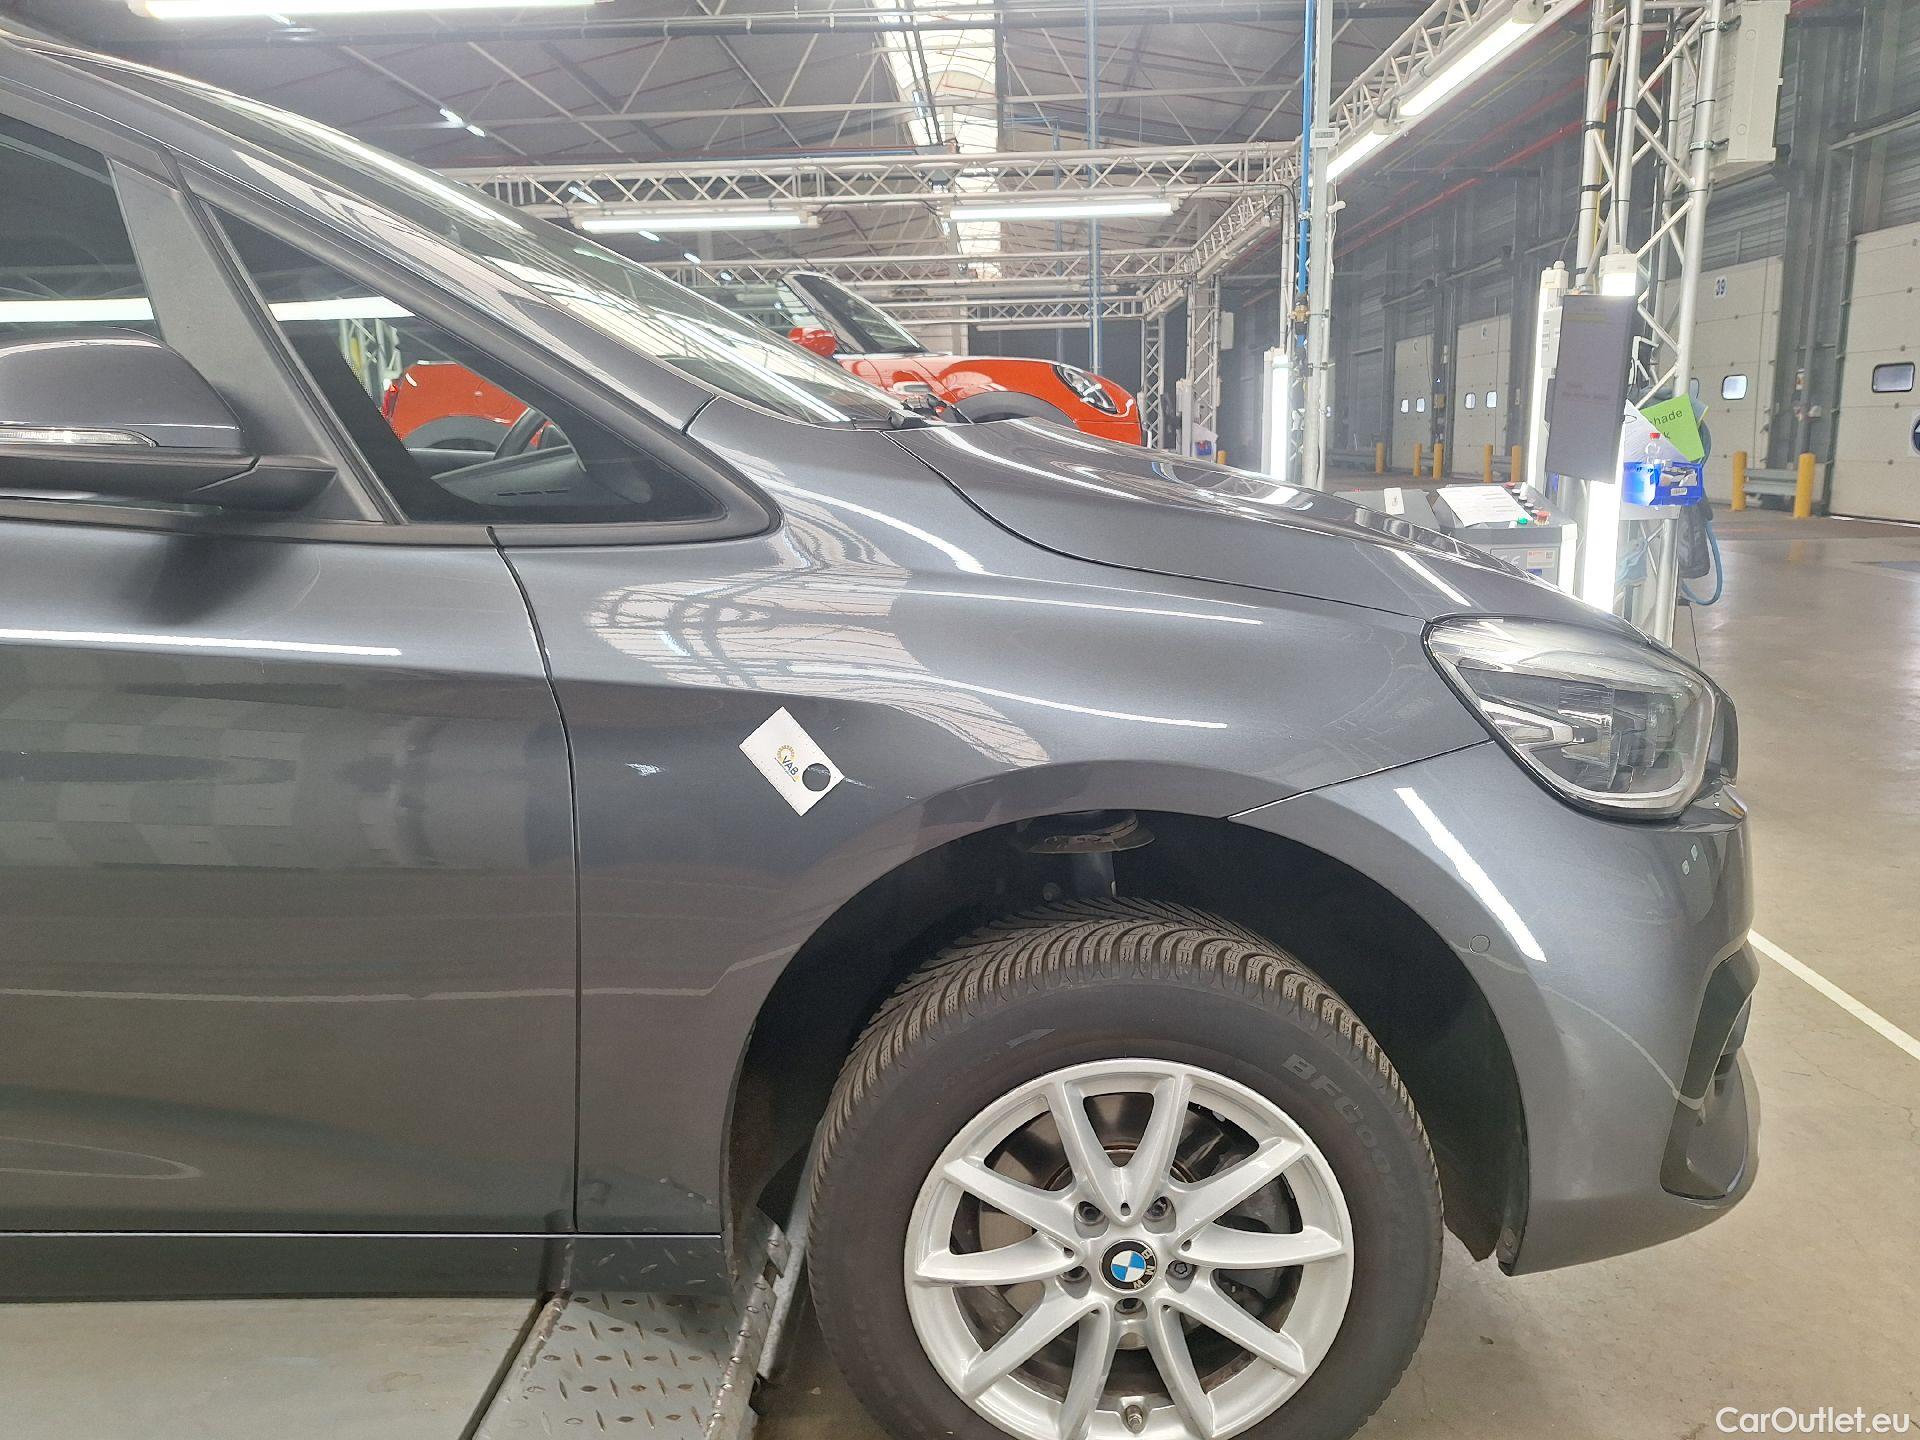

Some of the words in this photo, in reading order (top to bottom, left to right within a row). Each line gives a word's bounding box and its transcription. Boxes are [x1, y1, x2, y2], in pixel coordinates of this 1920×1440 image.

[1716, 279, 1726, 296] 39
[1651, 410, 1683, 425] hade
[781, 755, 799, 776] VAB
[1132, 1248, 1156, 1290] BMW
